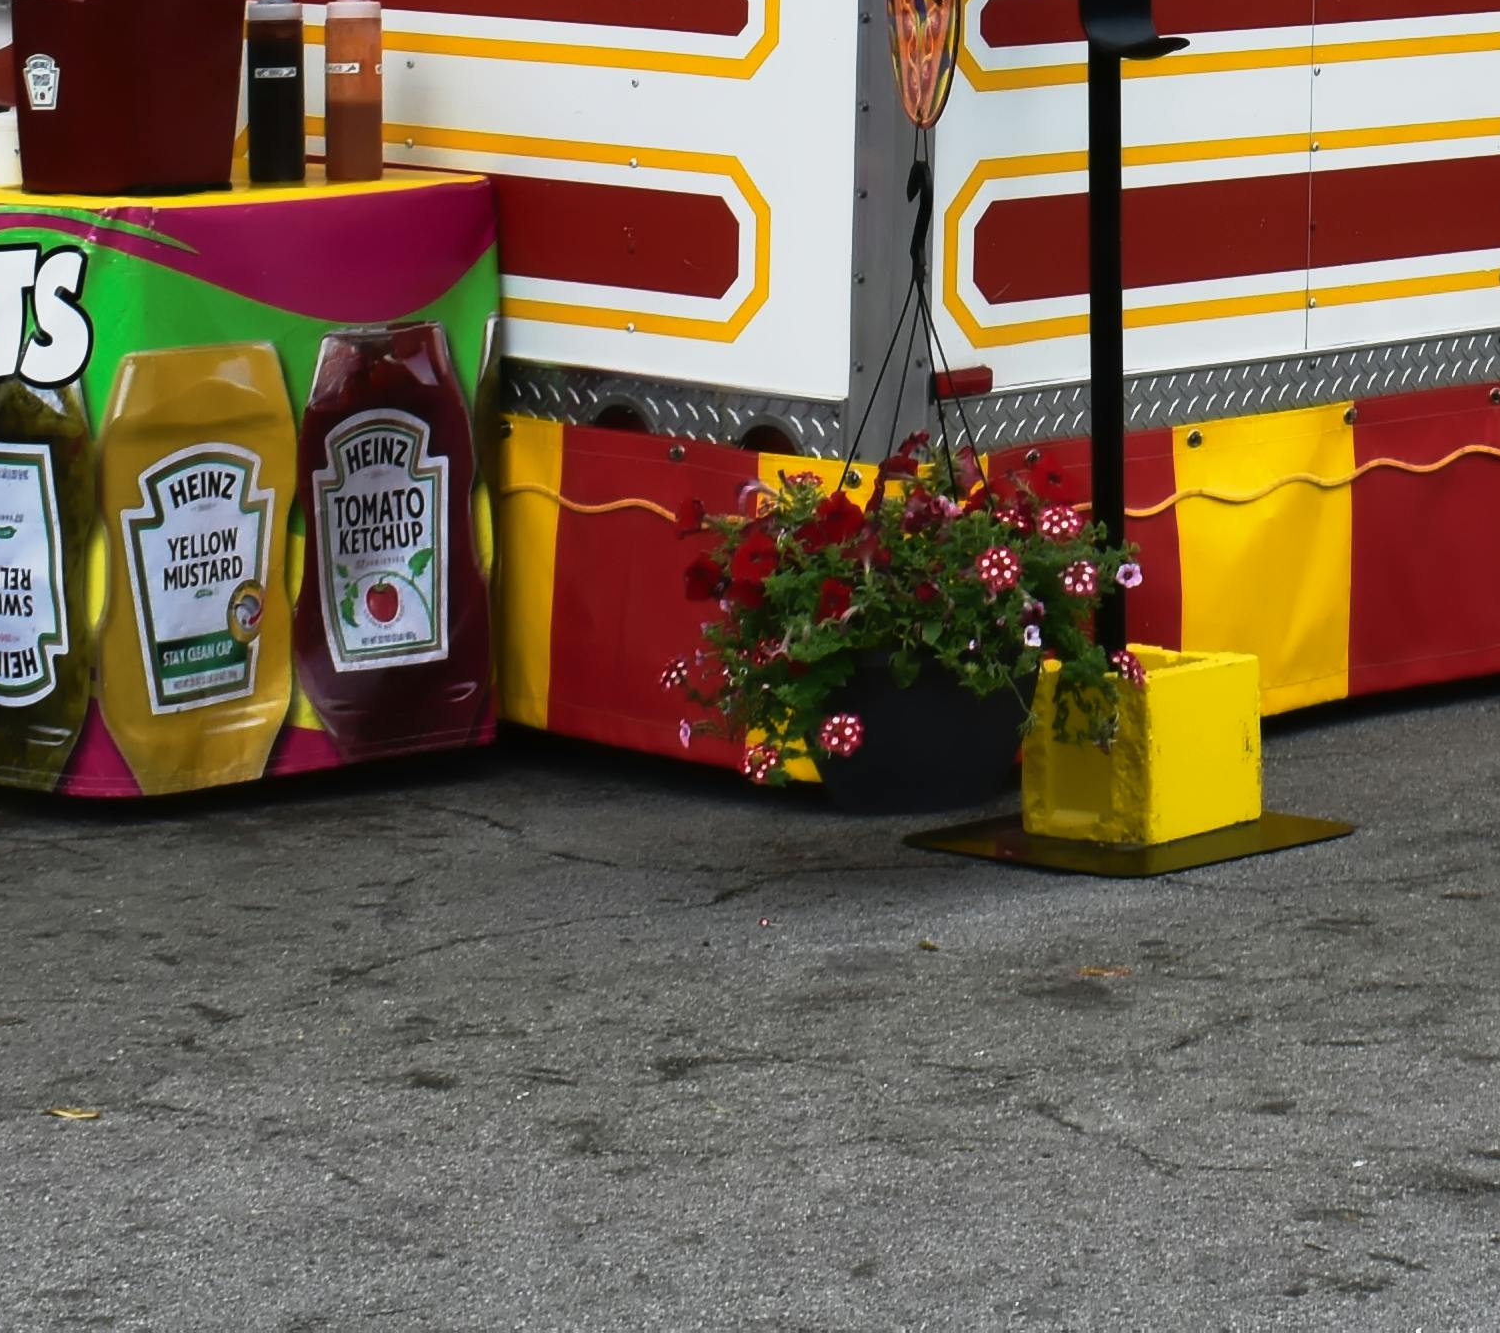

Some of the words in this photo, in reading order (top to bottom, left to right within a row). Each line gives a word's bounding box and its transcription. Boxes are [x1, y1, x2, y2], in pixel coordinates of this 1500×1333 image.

[345, 436, 408, 475] HEINZ
[168, 470, 237, 509] HEINZ
[334, 486, 425, 529] TOMATO
[167, 527, 239, 562] YELLOW
[338, 520, 424, 555] KETCHUP
[163, 555, 243, 591] MUSTARD
[163, 648, 185, 667] STAY
[187, 642, 217, 661] CLEAN
